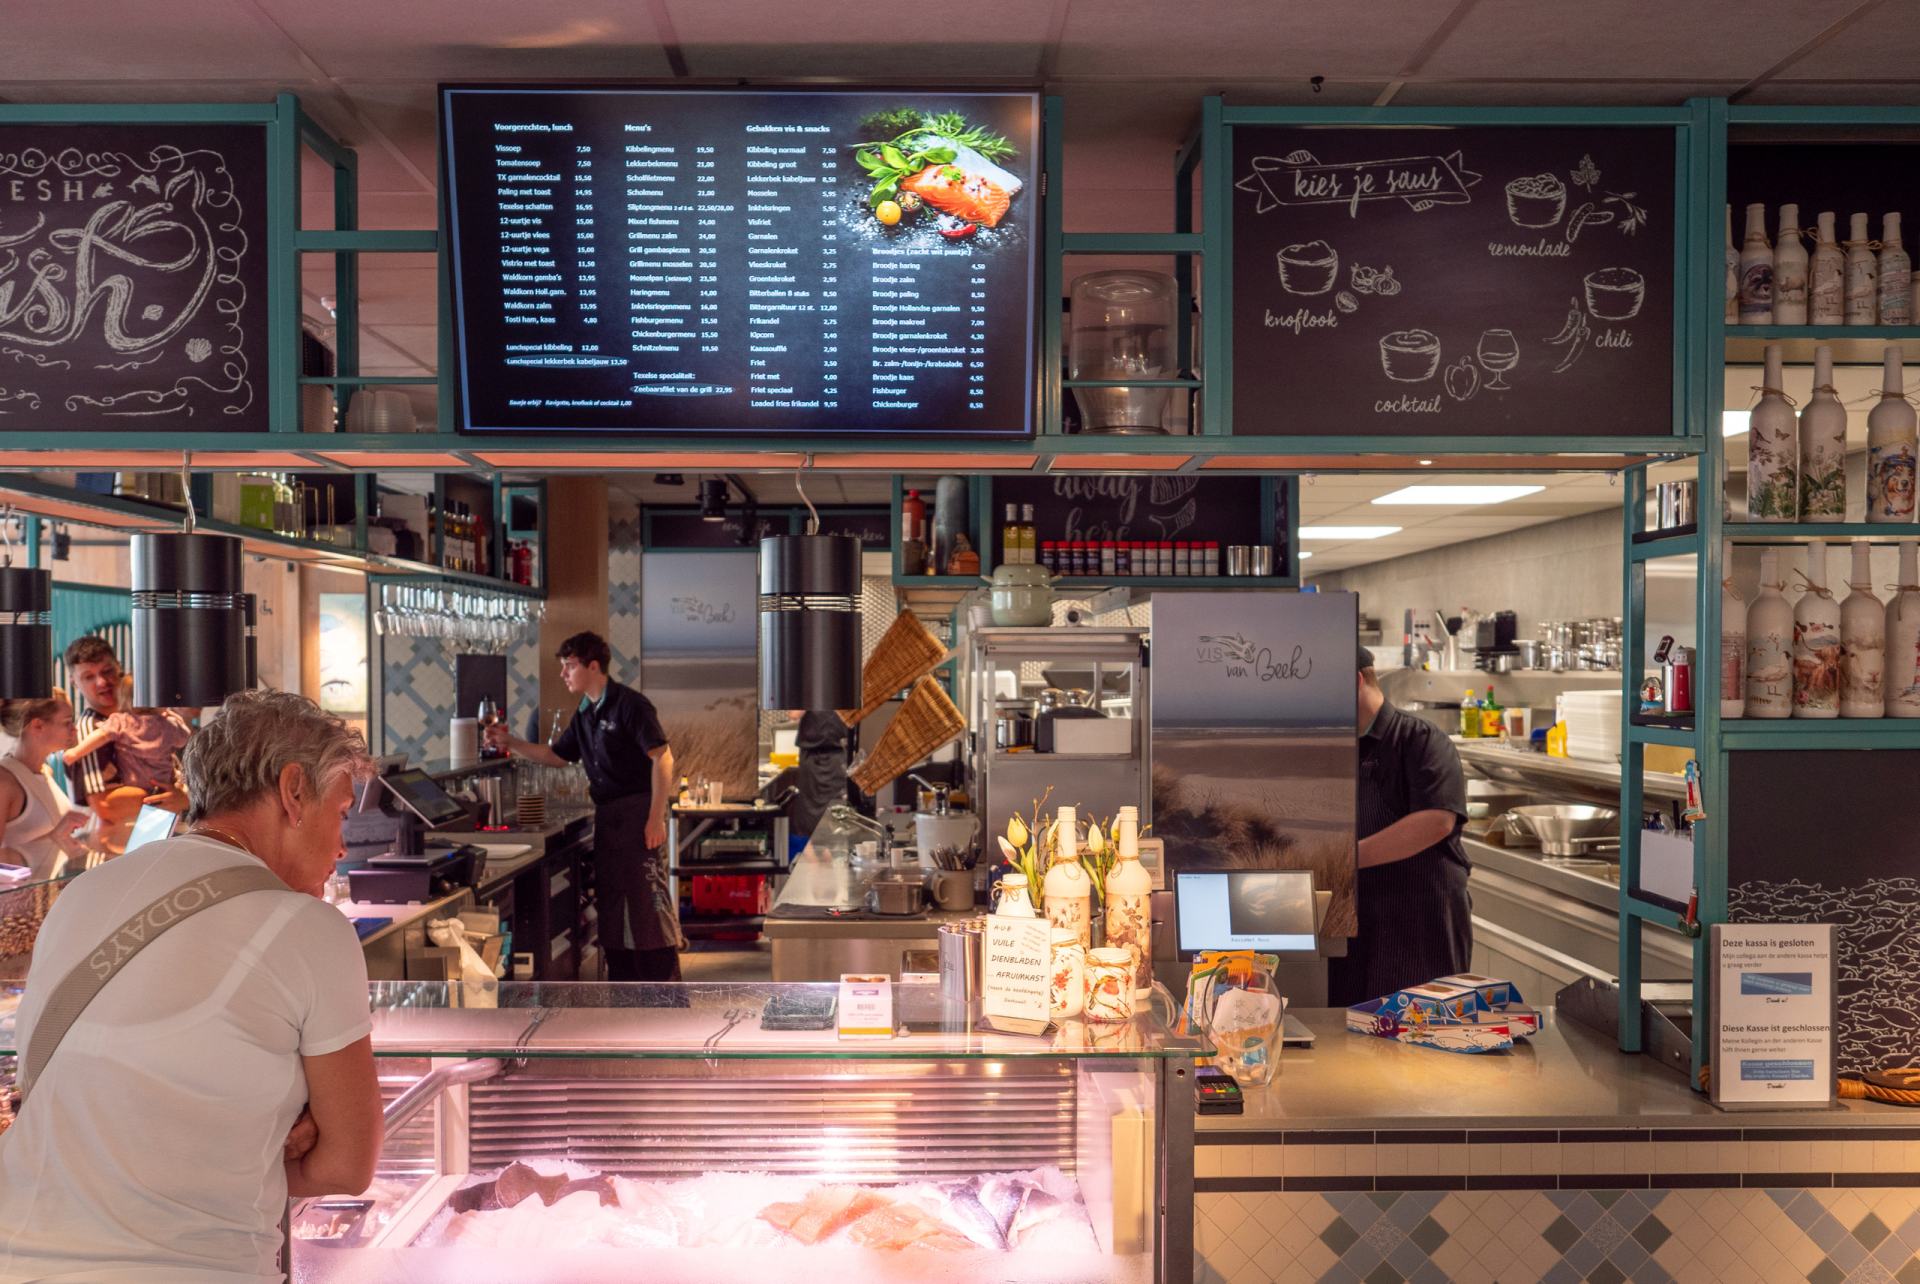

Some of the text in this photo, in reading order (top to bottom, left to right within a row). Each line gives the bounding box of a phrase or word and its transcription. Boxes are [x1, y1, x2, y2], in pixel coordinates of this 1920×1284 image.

[495, 124, 550, 132] Voorgerechten,
[508, 174, 560, 182] garnalencocktail
[1295, 166, 1442, 218] kies je saus
[1488, 240, 1571, 258] remoulade
[1265, 310, 1338, 335] knoflook
[1596, 329, 1633, 349] chili
[1374, 394, 1442, 413] cocktail
[1197, 647, 1223, 660] VIS
[1227, 645, 1312, 681] van Beek
[993, 939, 1016, 947] VUILE
[1779, 939, 1814, 948] gesloten
[992, 955, 1041, 966] DIENBLADEN
[996, 971, 1045, 982] AFRUIMKAST
[1782, 1024, 1830, 1033] geschlossen
